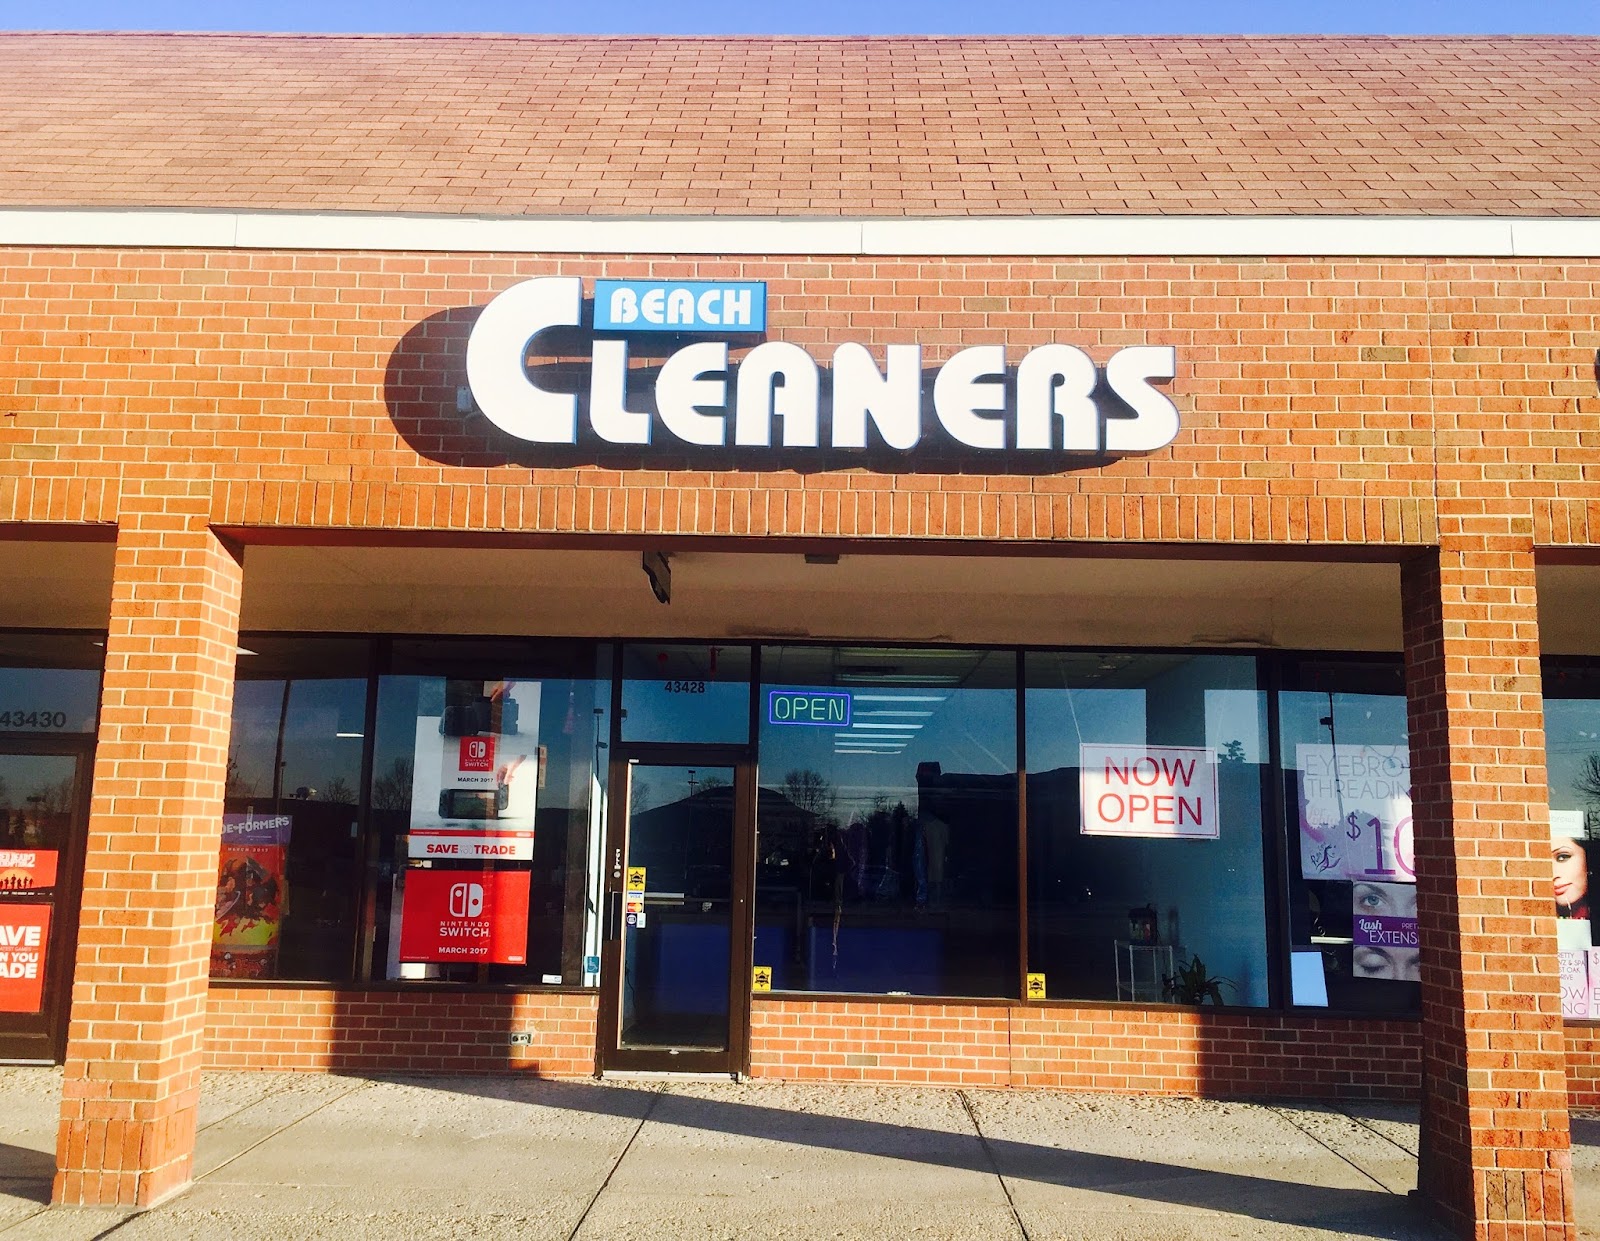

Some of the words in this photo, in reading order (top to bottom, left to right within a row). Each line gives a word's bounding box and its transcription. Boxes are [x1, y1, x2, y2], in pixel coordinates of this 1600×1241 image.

[610, 287, 752, 325] BEACH
[466, 276, 1181, 452] CLEANERS
[664, 681, 705, 694] 43428
[775, 697, 844, 721] OPEN
[0, 711, 67, 728] 43430
[1105, 756, 1196, 787] NOW
[1306, 754, 1410, 777] EYEBRO
[1098, 793, 1202, 825] OPEN
[426, 844, 459, 854] SAVE
[474, 844, 516, 855] TRADE
[440, 927, 491, 938] SWITCH
[1359, 918, 1382, 933] Lash
[1401, 922, 1418, 930] PRET
[11, 952, 39, 963] YOU
[438, 946, 468, 954] MARCH
[469, 947, 489, 955] 2017
